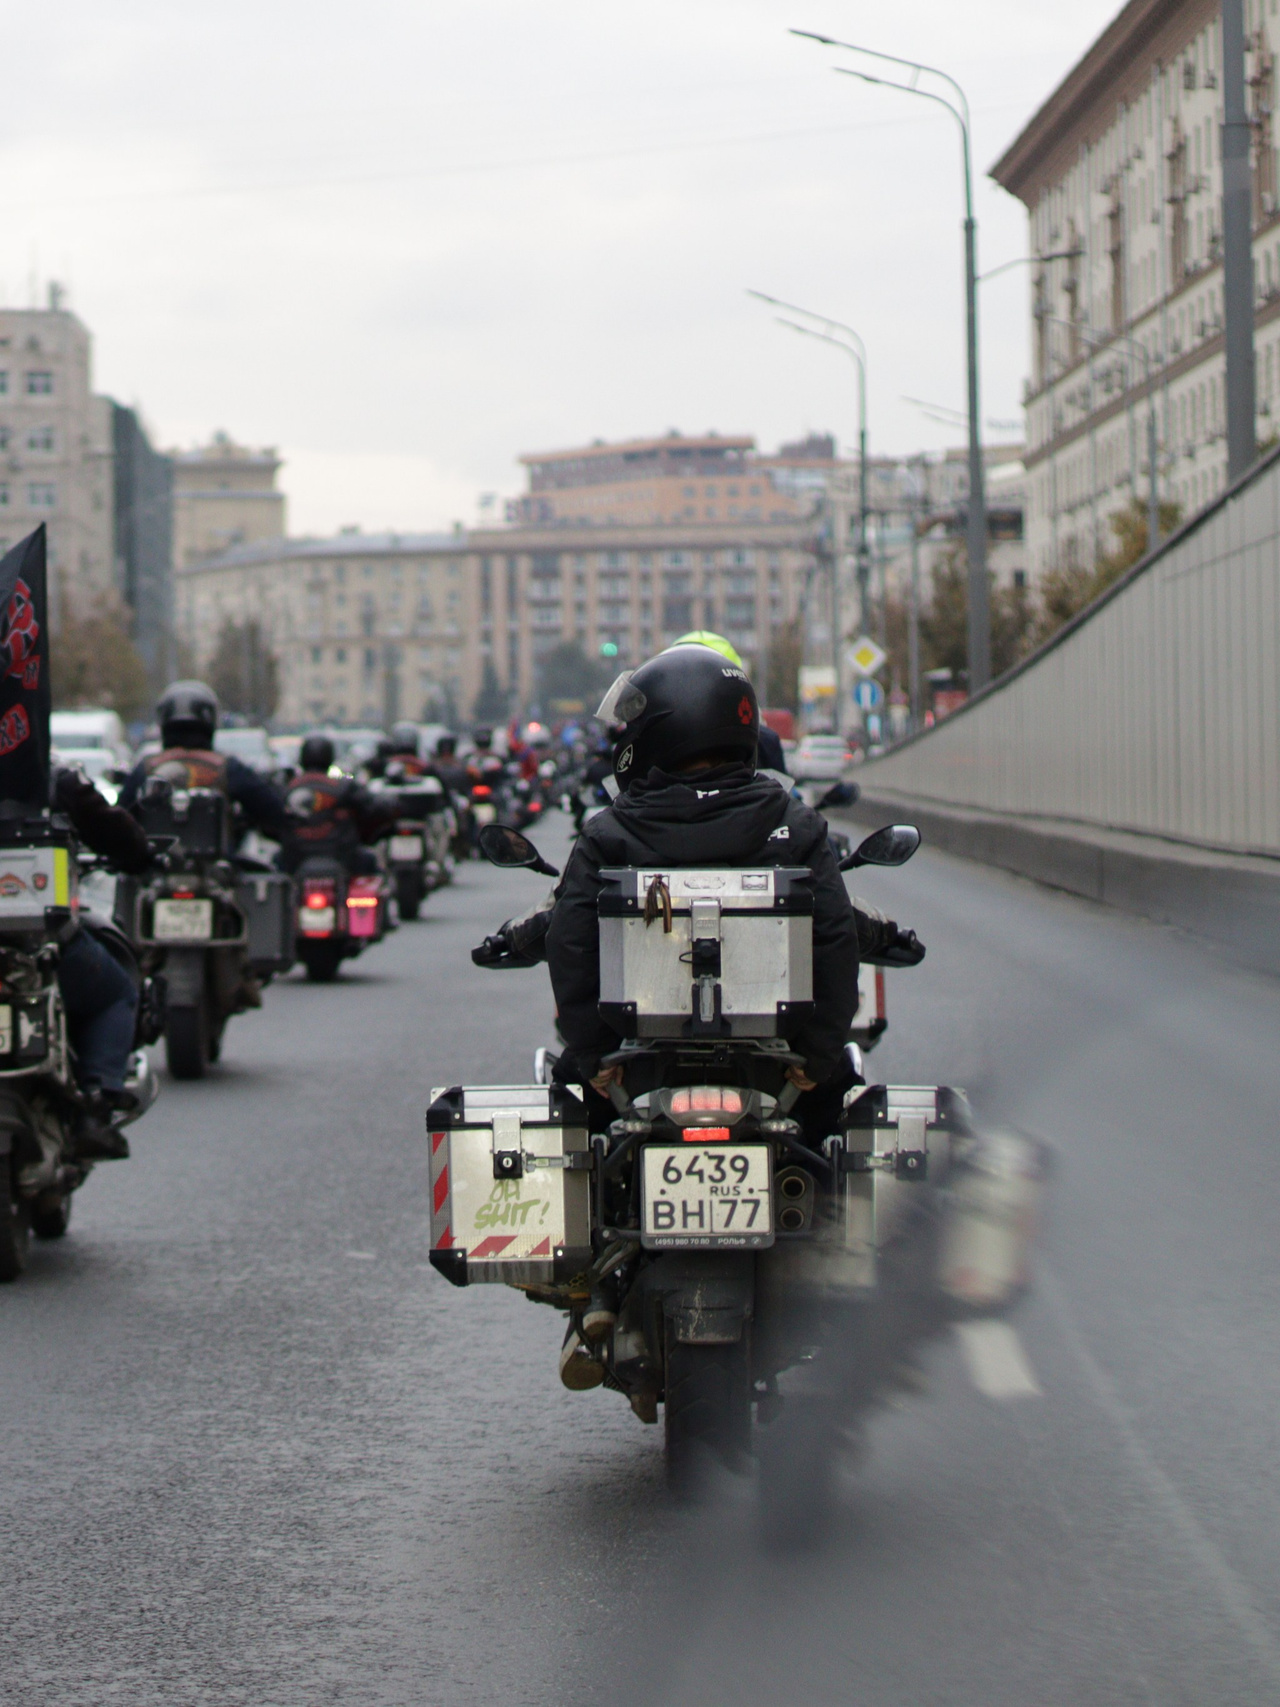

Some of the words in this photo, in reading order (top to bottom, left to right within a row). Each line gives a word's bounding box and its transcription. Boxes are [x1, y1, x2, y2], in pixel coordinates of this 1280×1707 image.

[662, 1154, 750, 1184] 6439
[710, 1186, 741, 1196] RUS
[718, 1198, 761, 1228] 77
